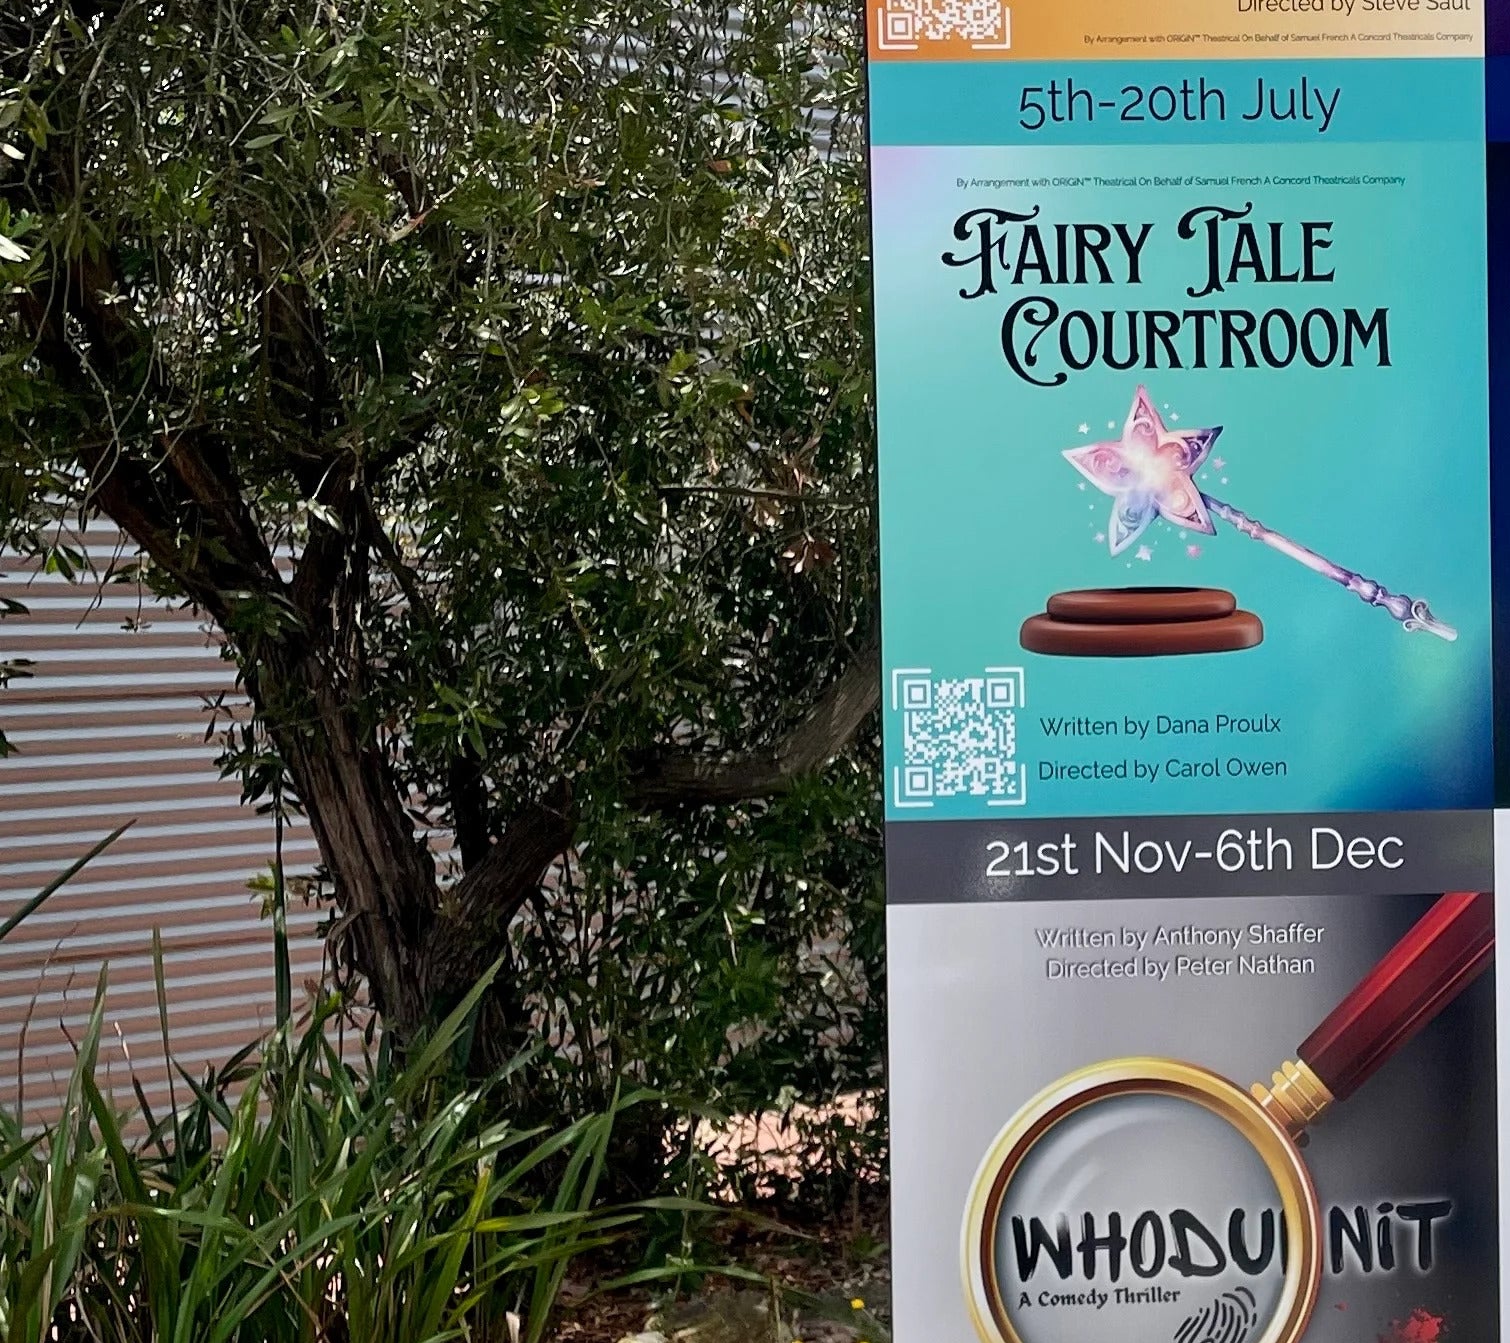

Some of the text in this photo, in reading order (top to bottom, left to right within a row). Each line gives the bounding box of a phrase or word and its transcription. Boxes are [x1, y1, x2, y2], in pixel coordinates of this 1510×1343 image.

[1020, 77, 1340, 132] 5th-20th July
[941, 201, 1335, 299] FAIRY TALE
[1000, 295, 1393, 387] COURTROOM
[1040, 714, 1281, 740] Written by Dana Proulx
[1039, 758, 1286, 783] Directed by Carol Owen
[986, 827, 1403, 877] 21st Nov-6th Dec
[1038, 923, 1324, 951] Written by Anthony Shaffer
[1047, 954, 1314, 981] Directed by Peter Nathan
[1016, 1286, 1180, 1312] A Comedy Thriller
